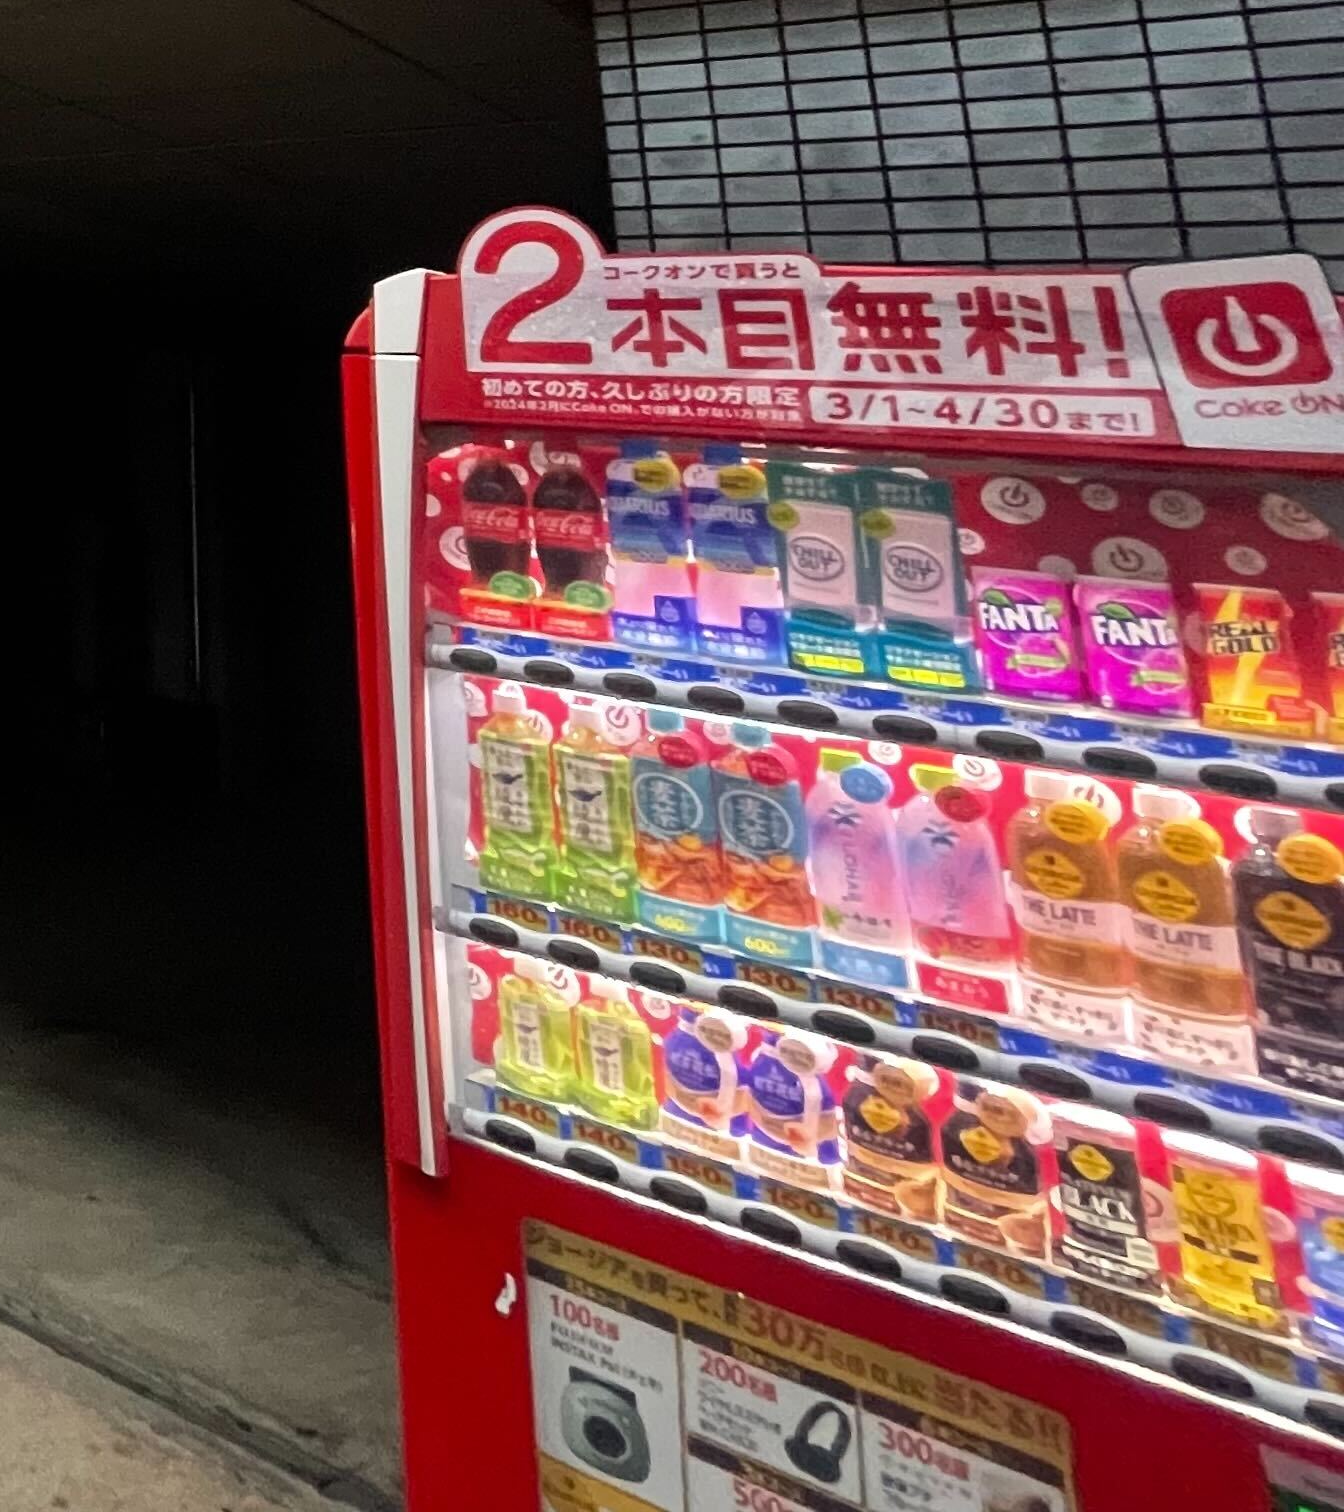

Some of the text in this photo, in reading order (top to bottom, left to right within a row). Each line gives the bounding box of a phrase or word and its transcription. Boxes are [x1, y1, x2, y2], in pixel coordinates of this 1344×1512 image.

[603, 262, 801, 281] コークオンで買うと
[1194, 397, 1284, 419] Coke
[979, 600, 1059, 632] FANTA
